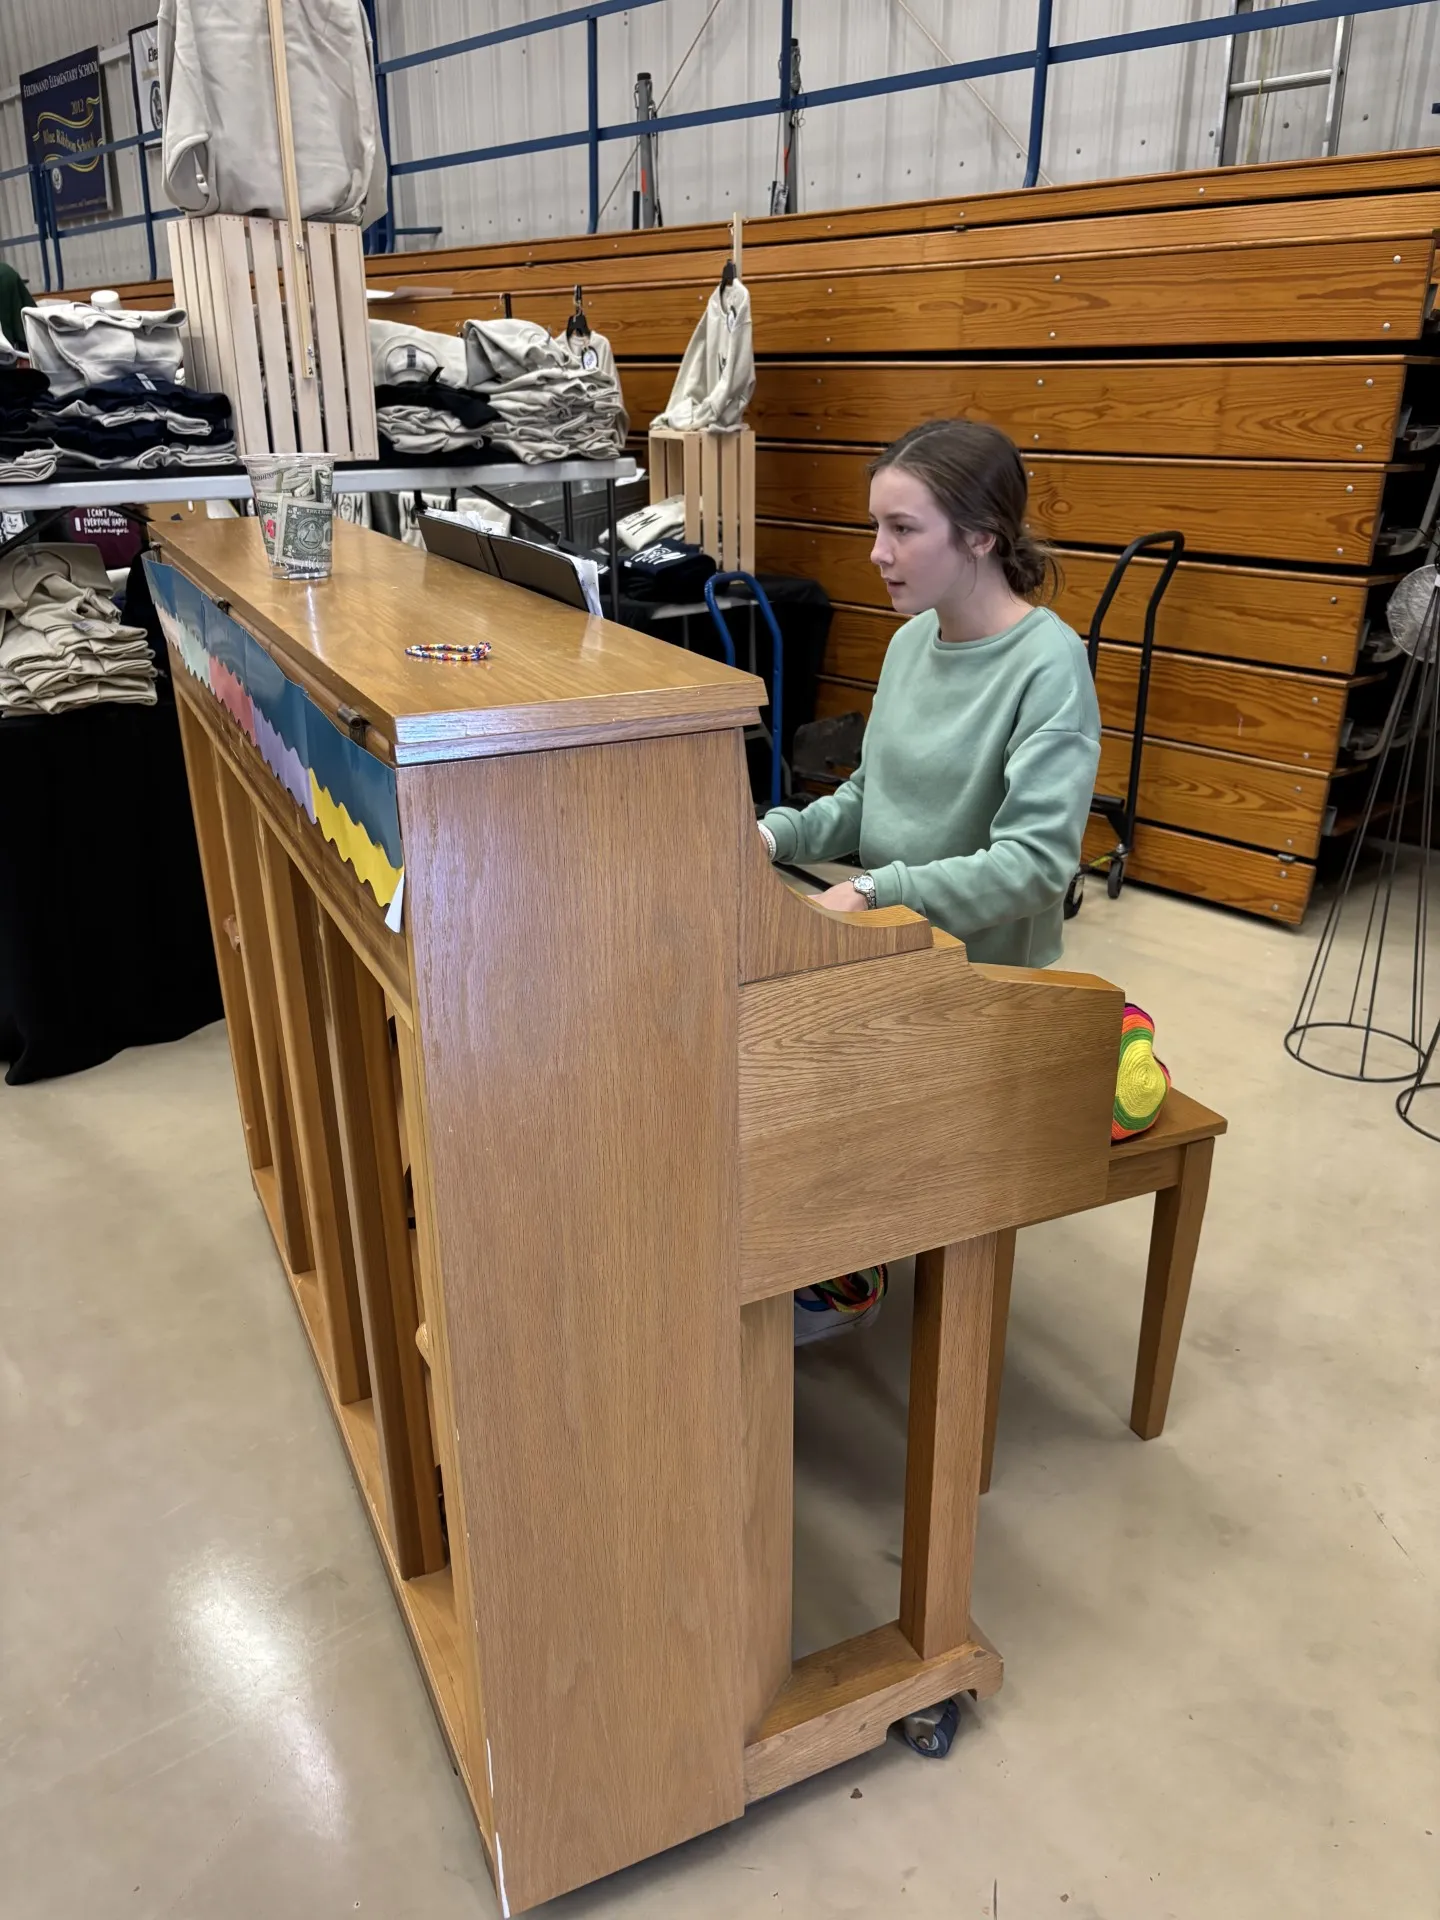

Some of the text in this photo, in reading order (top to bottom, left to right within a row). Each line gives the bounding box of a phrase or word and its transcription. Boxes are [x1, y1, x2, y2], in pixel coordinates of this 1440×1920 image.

[148, 46, 159, 62] Ele
[23, 60, 99, 98] FERDINAND ELEMENTARY SCHOOL
[70, 98, 84, 116] 2012
[43, 128, 96, 153] Blue Ribbon School
[83, 517, 110, 527] EVERYONE
